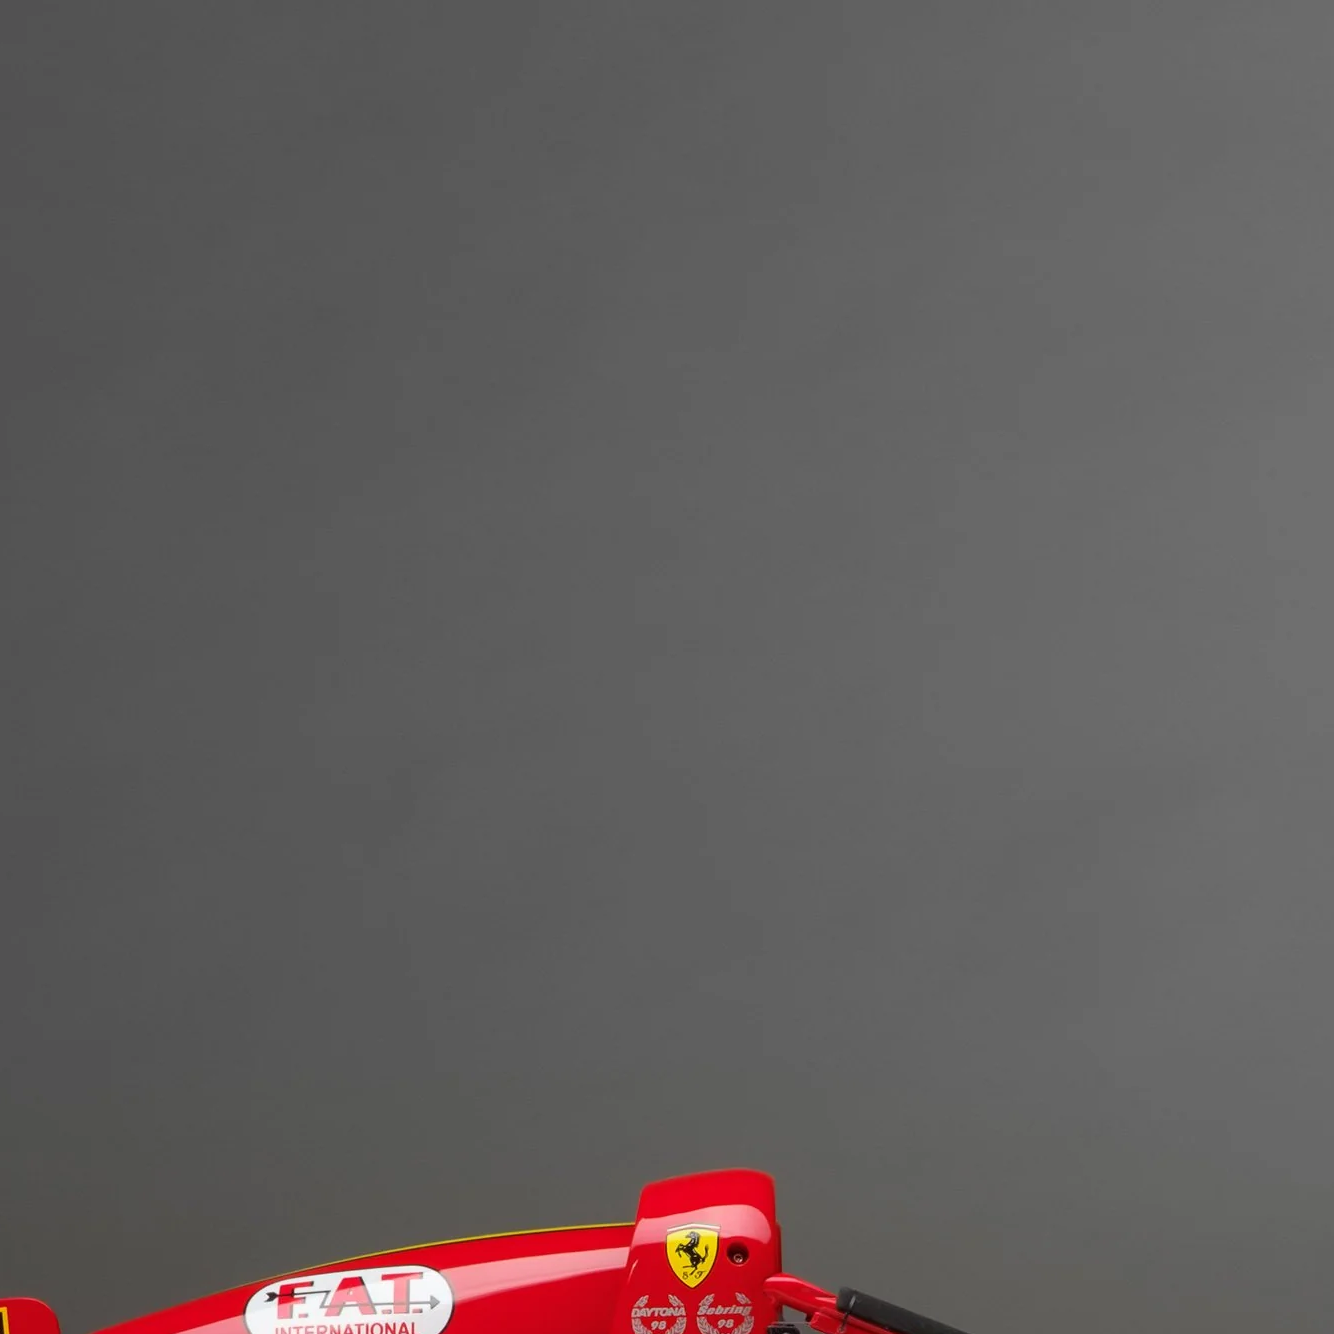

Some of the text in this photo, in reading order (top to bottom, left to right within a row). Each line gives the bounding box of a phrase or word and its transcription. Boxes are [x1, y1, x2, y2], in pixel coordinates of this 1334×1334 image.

[631, 1307, 686, 1317] DAYTONA
[697, 1305, 752, 1316] Sebring
[651, 1321, 667, 1330] 98
[717, 1318, 734, 1328] 98
